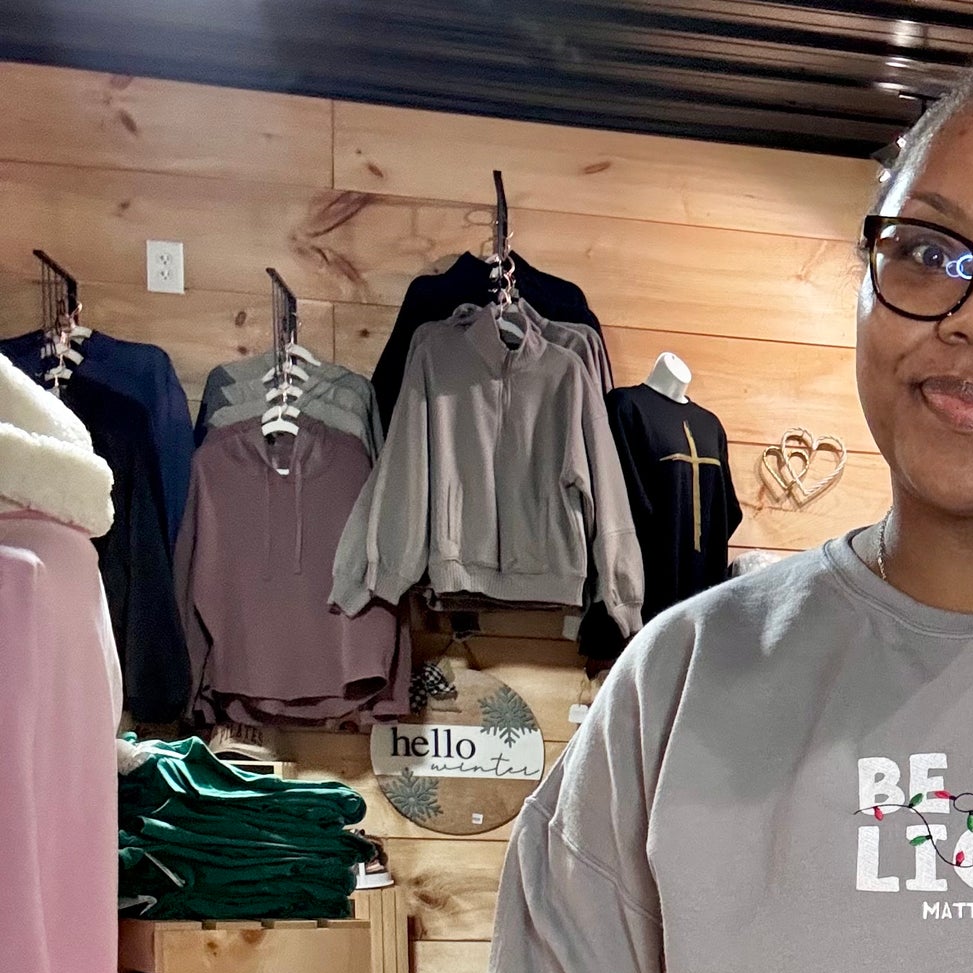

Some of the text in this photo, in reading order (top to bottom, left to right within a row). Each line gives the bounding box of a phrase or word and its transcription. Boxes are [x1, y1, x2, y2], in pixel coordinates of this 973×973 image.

[391, 727, 476, 760] hello
[431, 753, 540, 777] winter
[857, 752, 950, 815] BE
